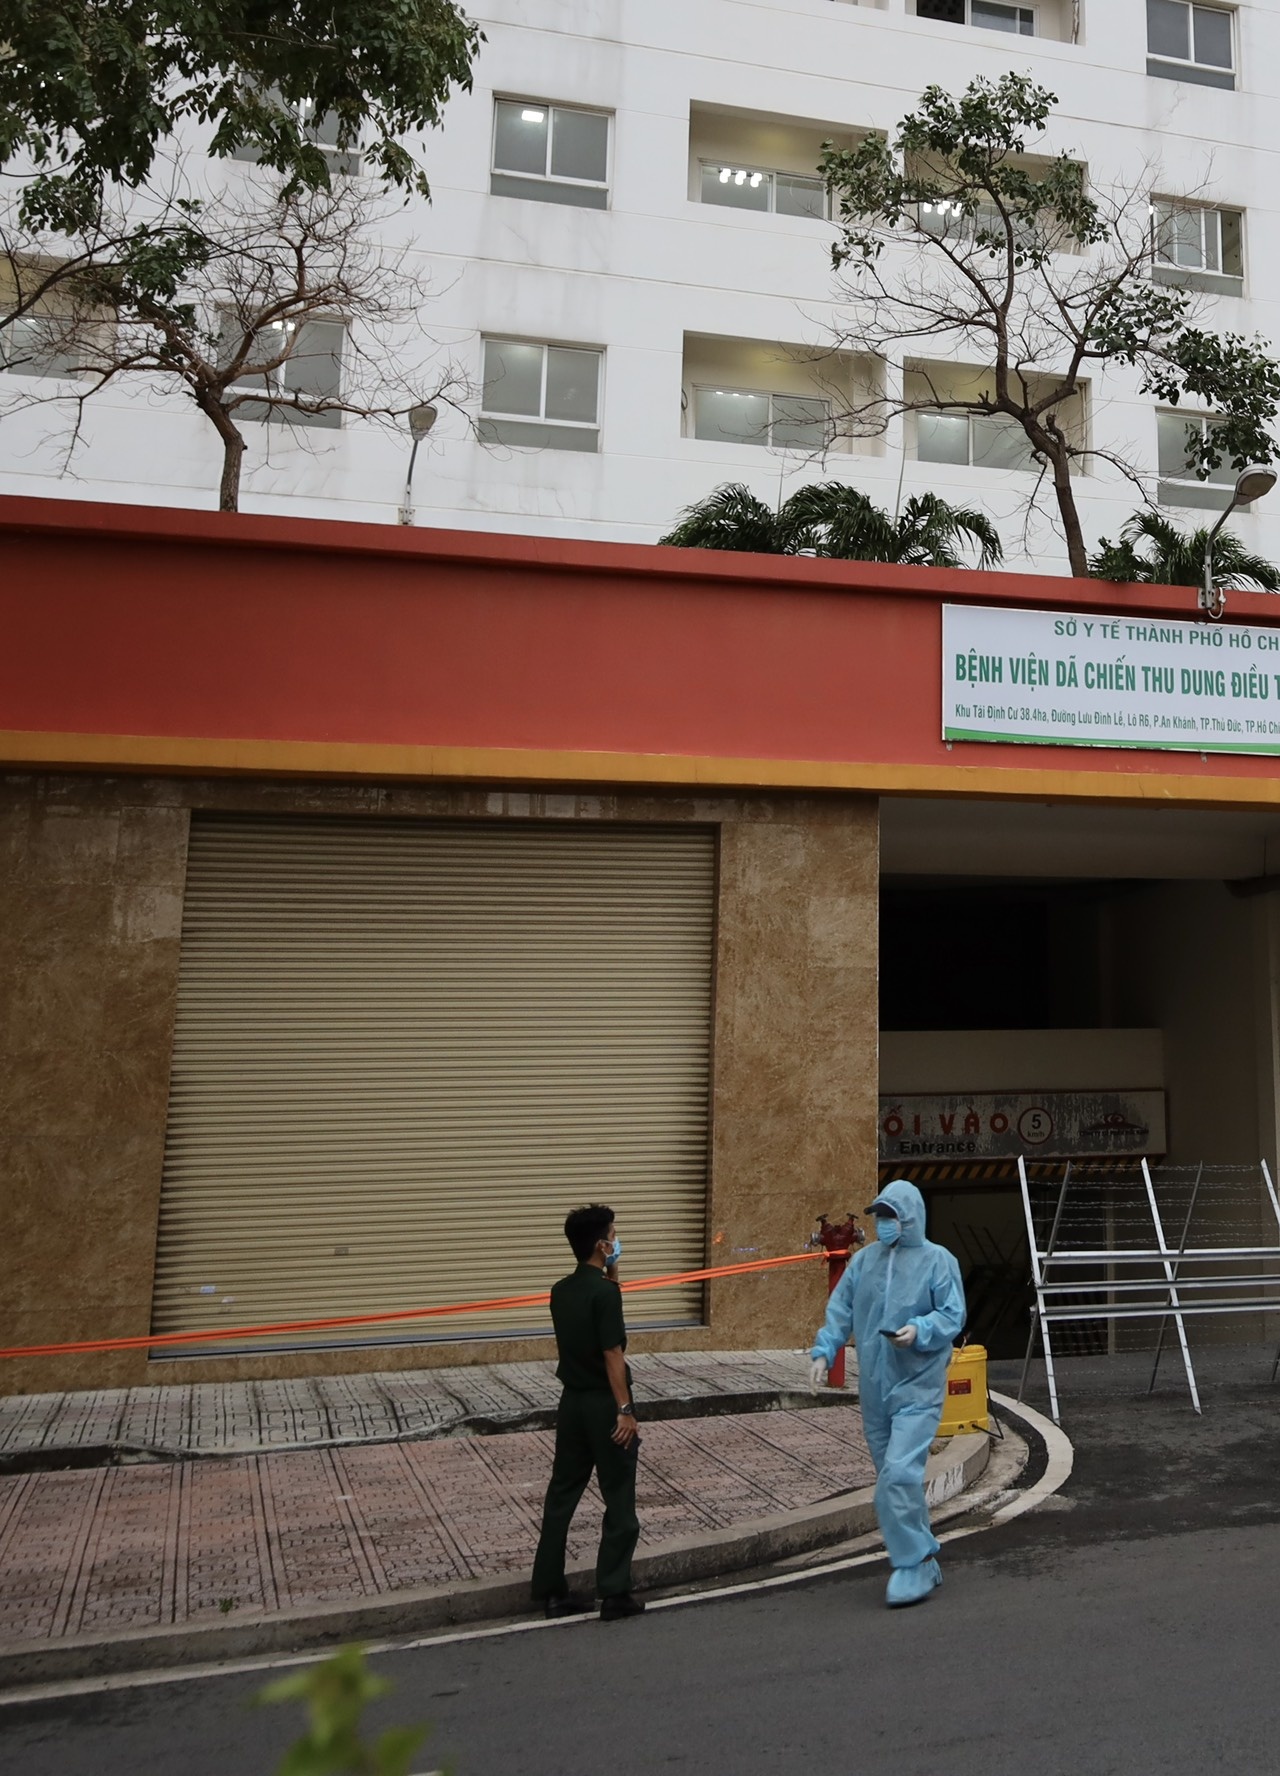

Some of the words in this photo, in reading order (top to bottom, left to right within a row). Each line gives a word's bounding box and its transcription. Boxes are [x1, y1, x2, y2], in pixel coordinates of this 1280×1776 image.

[1054, 616, 1077, 637] SỞ
[1083, 622, 1094, 638] Y
[1100, 619, 1121, 640] TẾ
[1125, 623, 1183, 645] THÀNH
[1189, 627, 1223, 647] PHỐ
[1229, 629, 1251, 649] HỒ
[955, 648, 1003, 688] BỆNH
[1009, 652, 1049, 692] VIỆN
[1056, 655, 1079, 688] DÃ
[1084, 654, 1136, 691] CHIẾN
[1141, 665, 1175, 694] THU
[1181, 668, 1226, 697] DUNG
[1230, 663, 1269, 700] ĐIỀU
[955, 703, 971, 718] Khu
[973, 704, 985, 719] Tái
[987, 705, 1006, 722] Định
[1007, 706, 1018, 720] Cư
[1020, 707, 1050, 724] 38.4ha,
[1051, 709, 1076, 726] Đường
[1094, 711, 1112, 725] Đình
[1139, 714, 1152, 729] R6,
[1153, 715, 1170, 729] P.An
[1173, 715, 1199, 731] Khánh,
[1200, 717, 1226, 731] TP.Thủ
[1227, 719, 1244, 734] Đức,
[1269, 721, 1280, 734] Chí
[883, 1104, 921, 1137] ỐI
[939, 1104, 1009, 1135] VÀO
[1031, 1113, 1042, 1130] 5
[900, 1140, 977, 1154] Entrance
